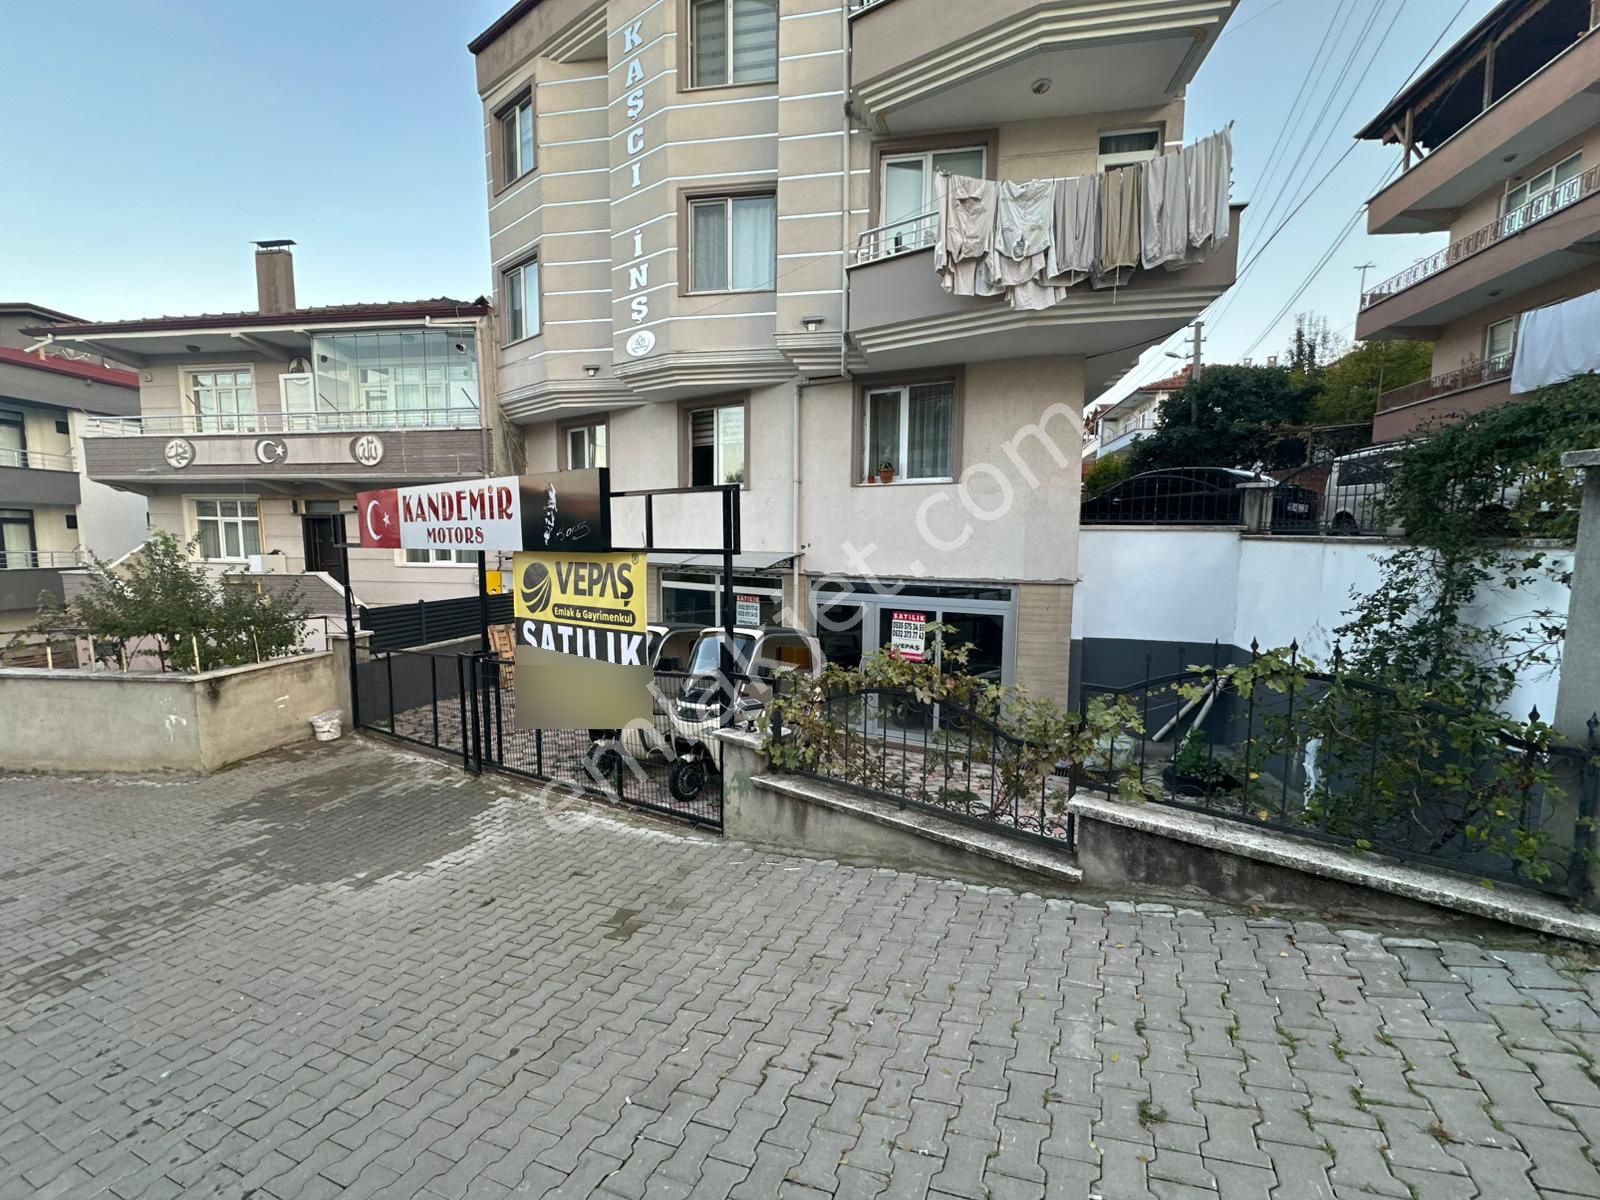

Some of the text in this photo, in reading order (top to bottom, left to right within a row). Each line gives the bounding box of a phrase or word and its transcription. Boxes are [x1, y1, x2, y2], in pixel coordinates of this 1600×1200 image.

[402, 485, 514, 523] KANDEMİR
[426, 526, 484, 544] MOTORS
[555, 561, 634, 607] VEPAŞ
[554, 607, 633, 624] Emlak & Gayrimenkul
